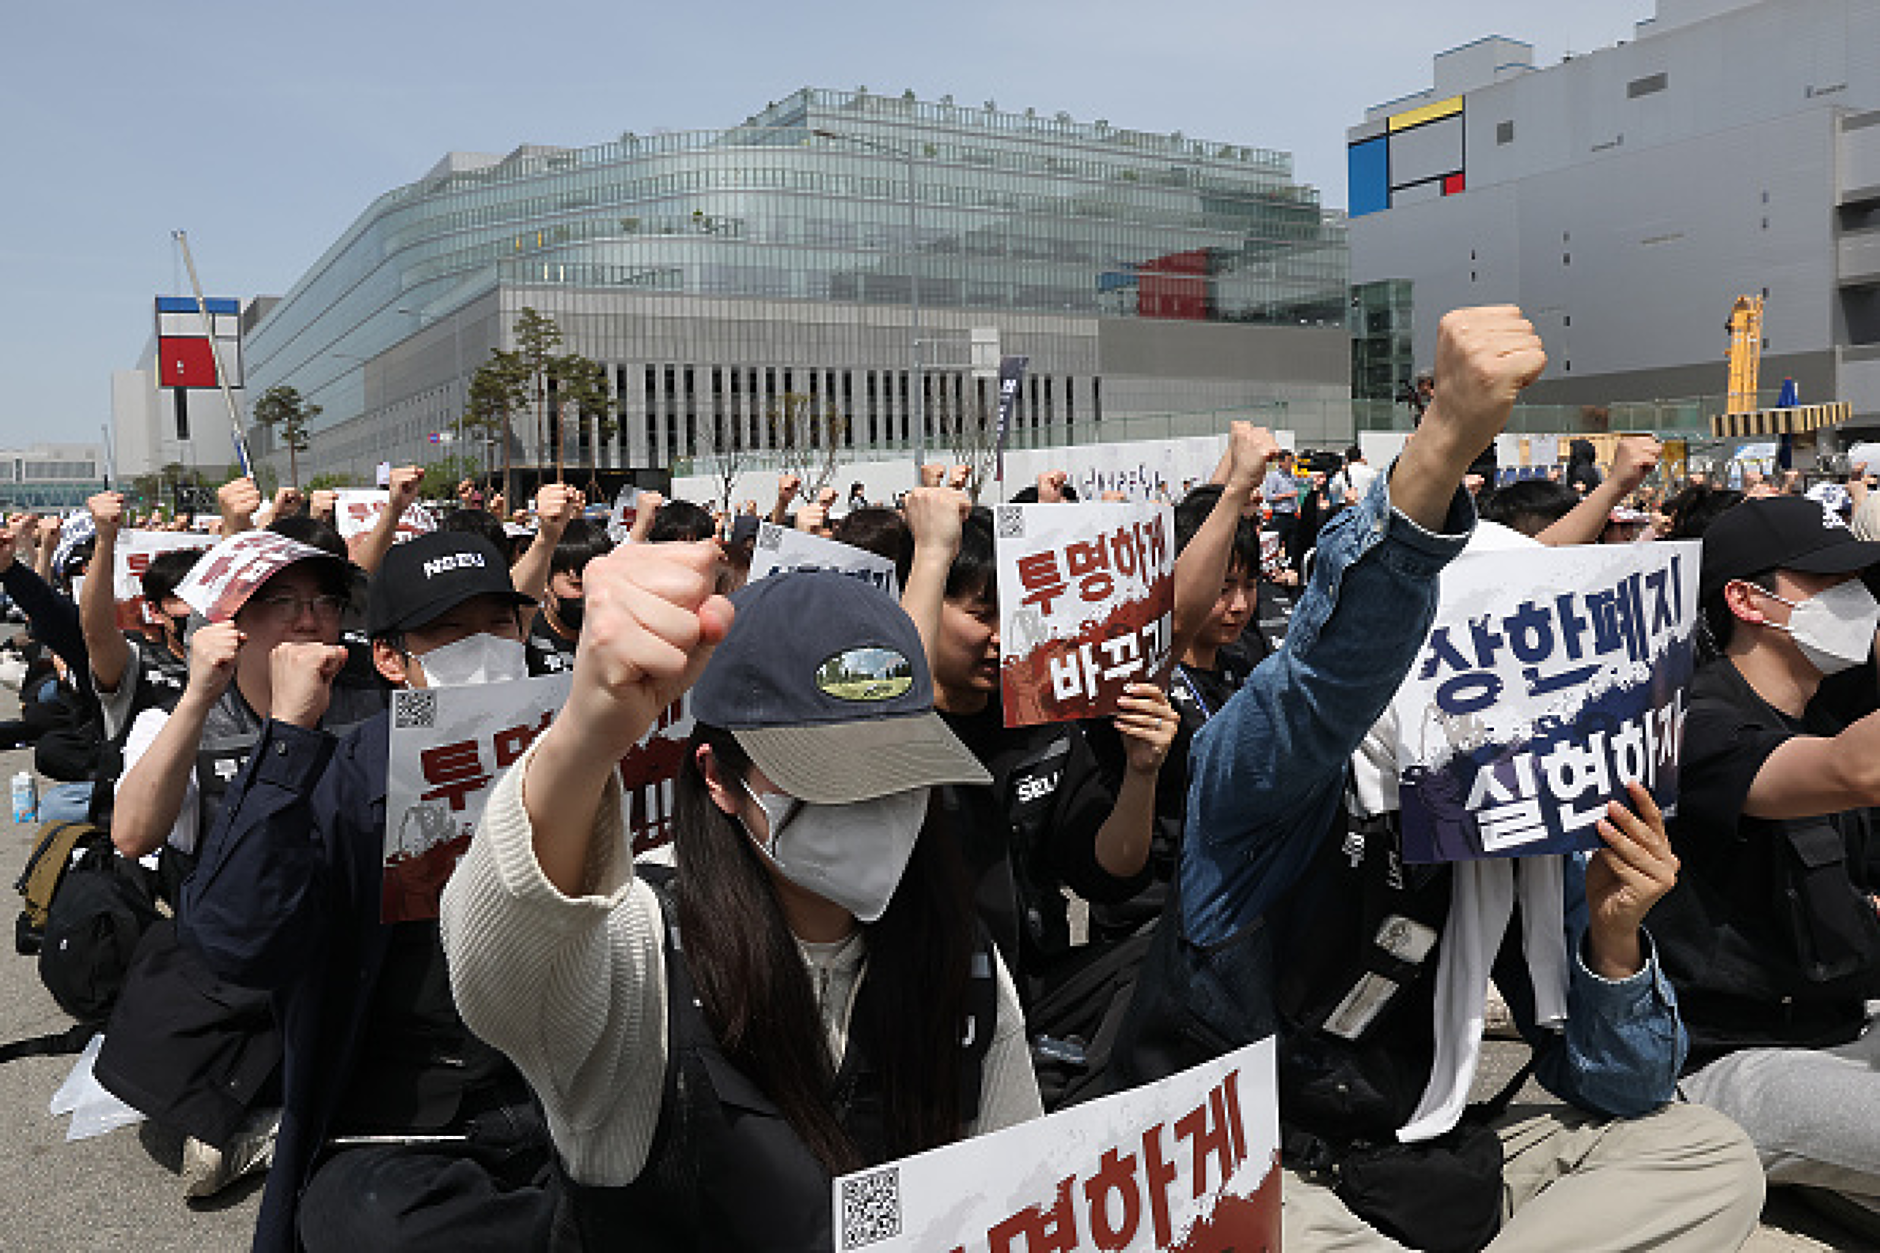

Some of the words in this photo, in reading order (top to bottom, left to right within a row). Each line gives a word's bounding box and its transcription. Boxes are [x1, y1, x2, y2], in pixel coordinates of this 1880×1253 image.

[1016, 513, 1166, 617] 투명하게
[1418, 554, 1682, 716] 상한폐지
[1465, 687, 1689, 852] 실현하자
